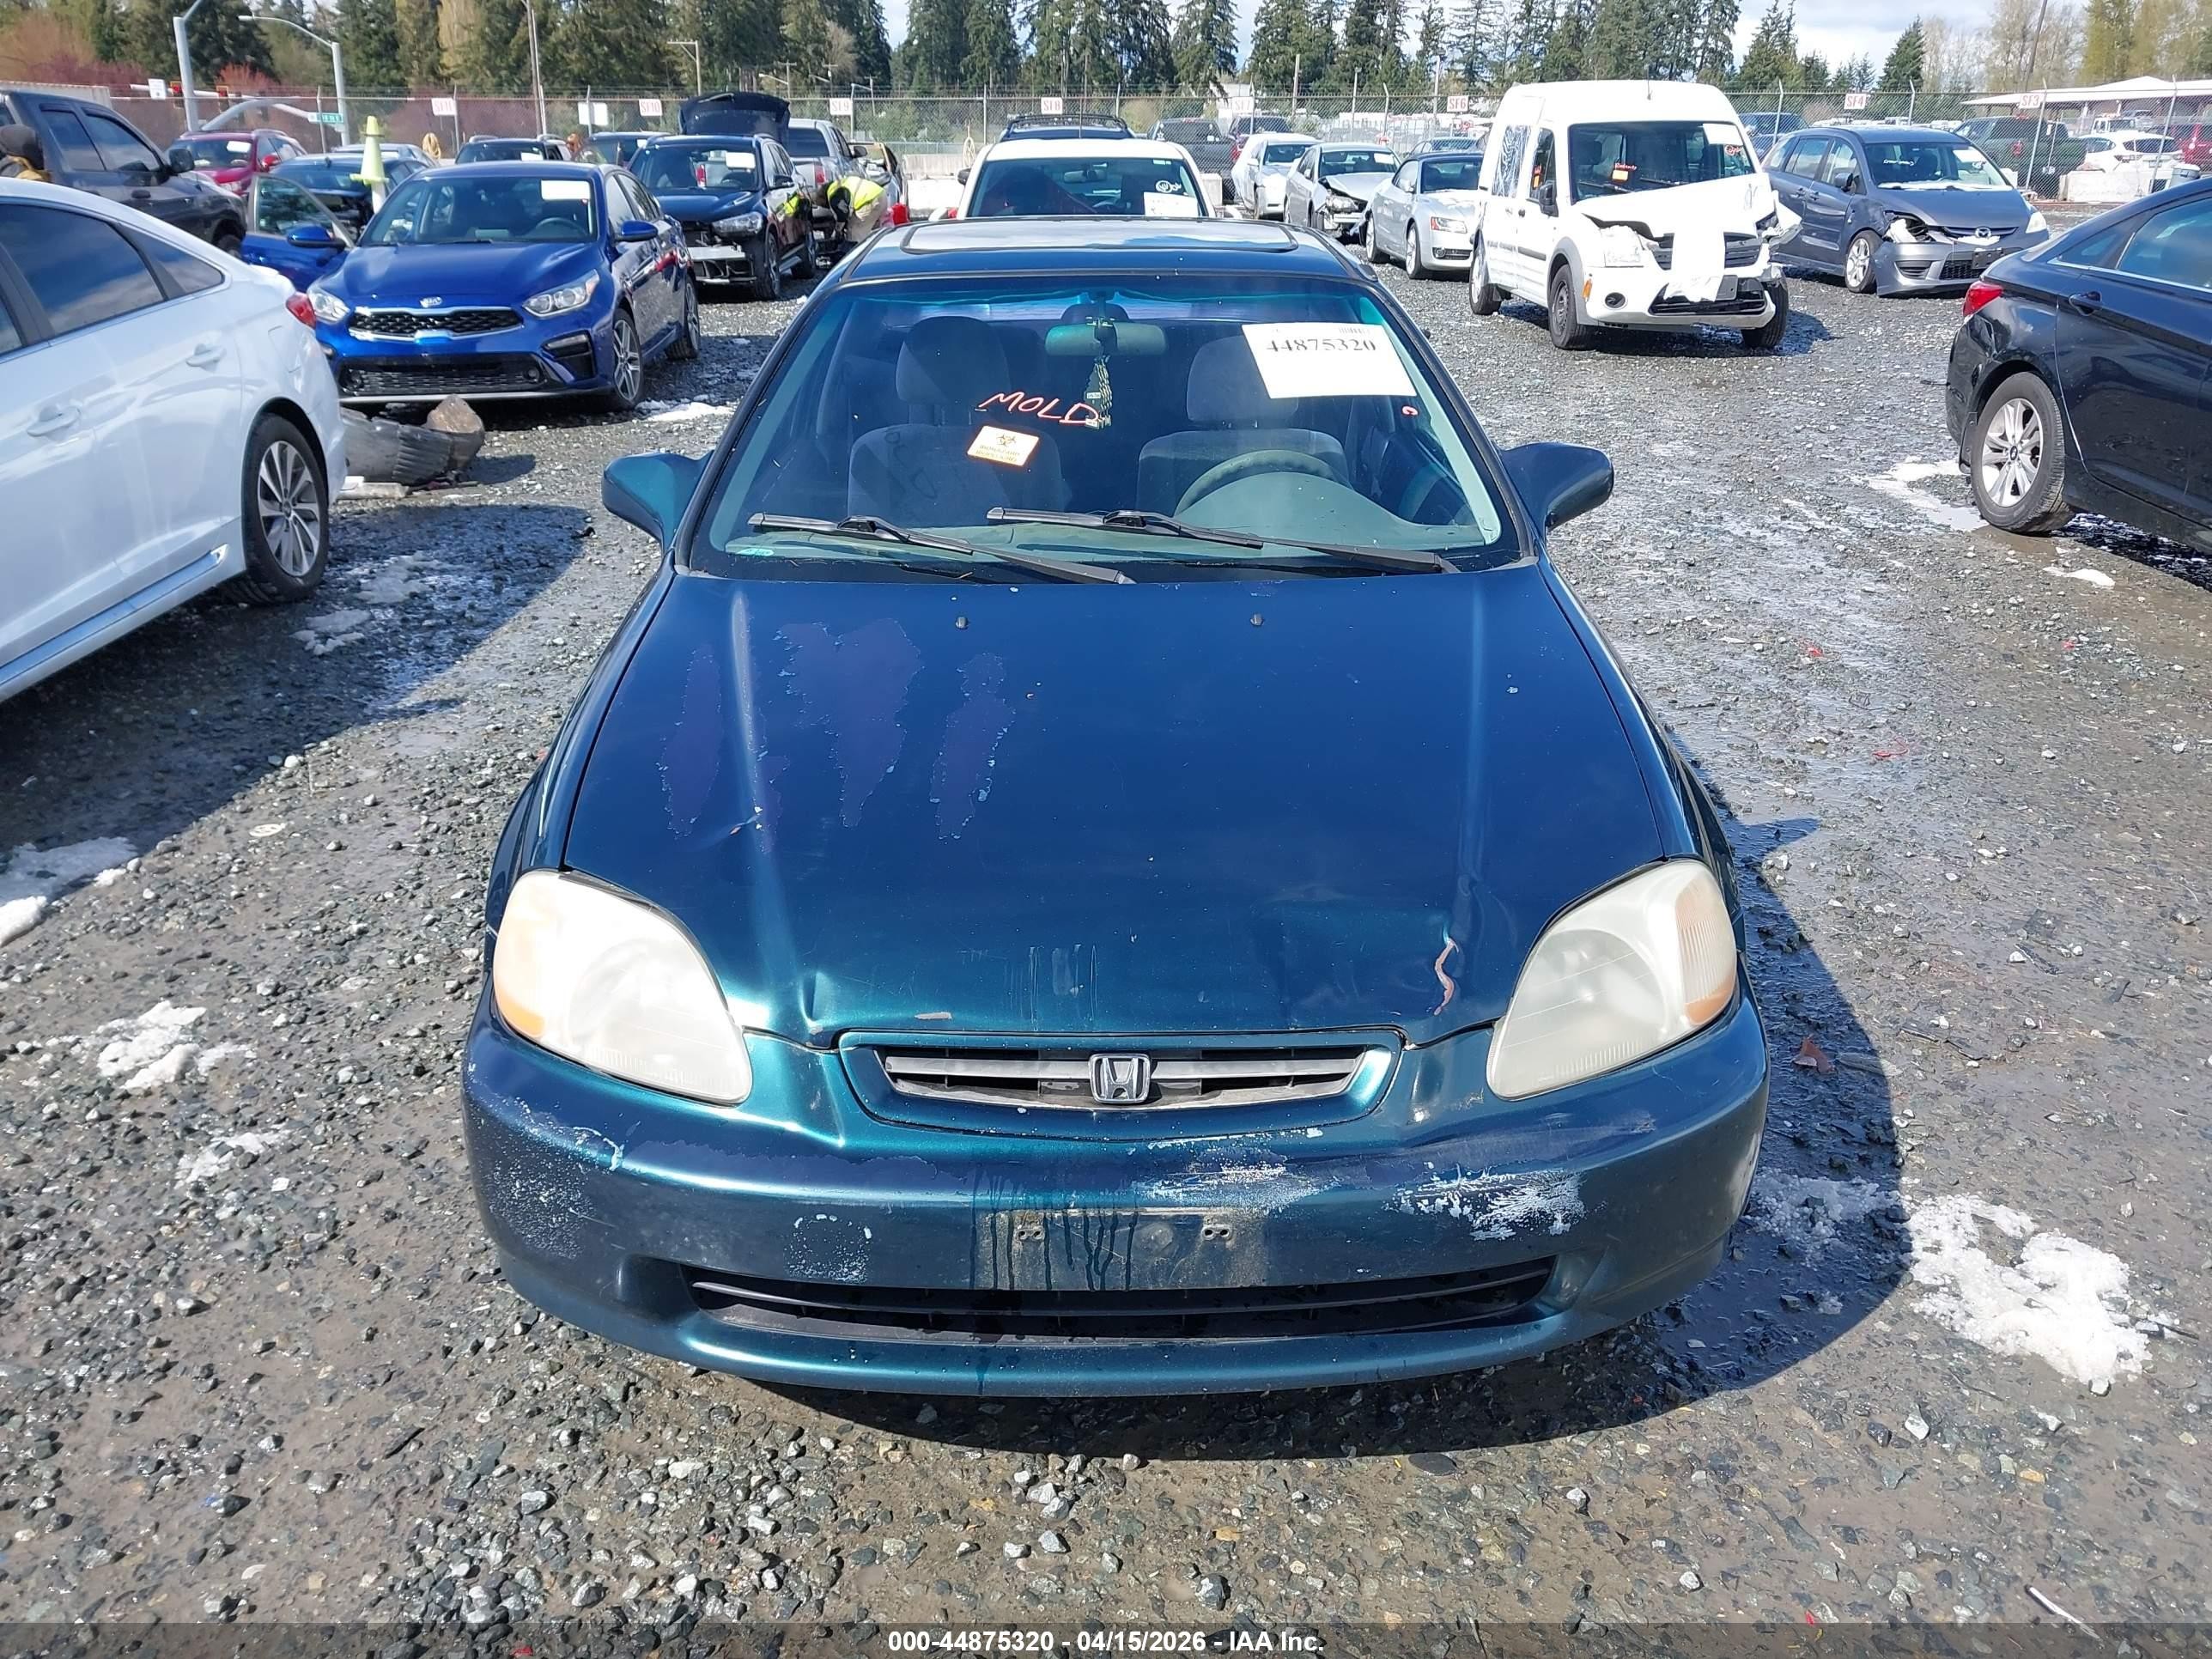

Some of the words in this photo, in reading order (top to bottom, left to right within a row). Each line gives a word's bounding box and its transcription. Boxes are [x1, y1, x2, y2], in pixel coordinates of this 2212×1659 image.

[1449, 97, 1467, 110] SF6
[1846, 95, 1864, 107] SF4
[2021, 94, 2039, 106] SF3
[1267, 337, 1377, 354] 44875320
[977, 391, 1100, 425] MOLD
